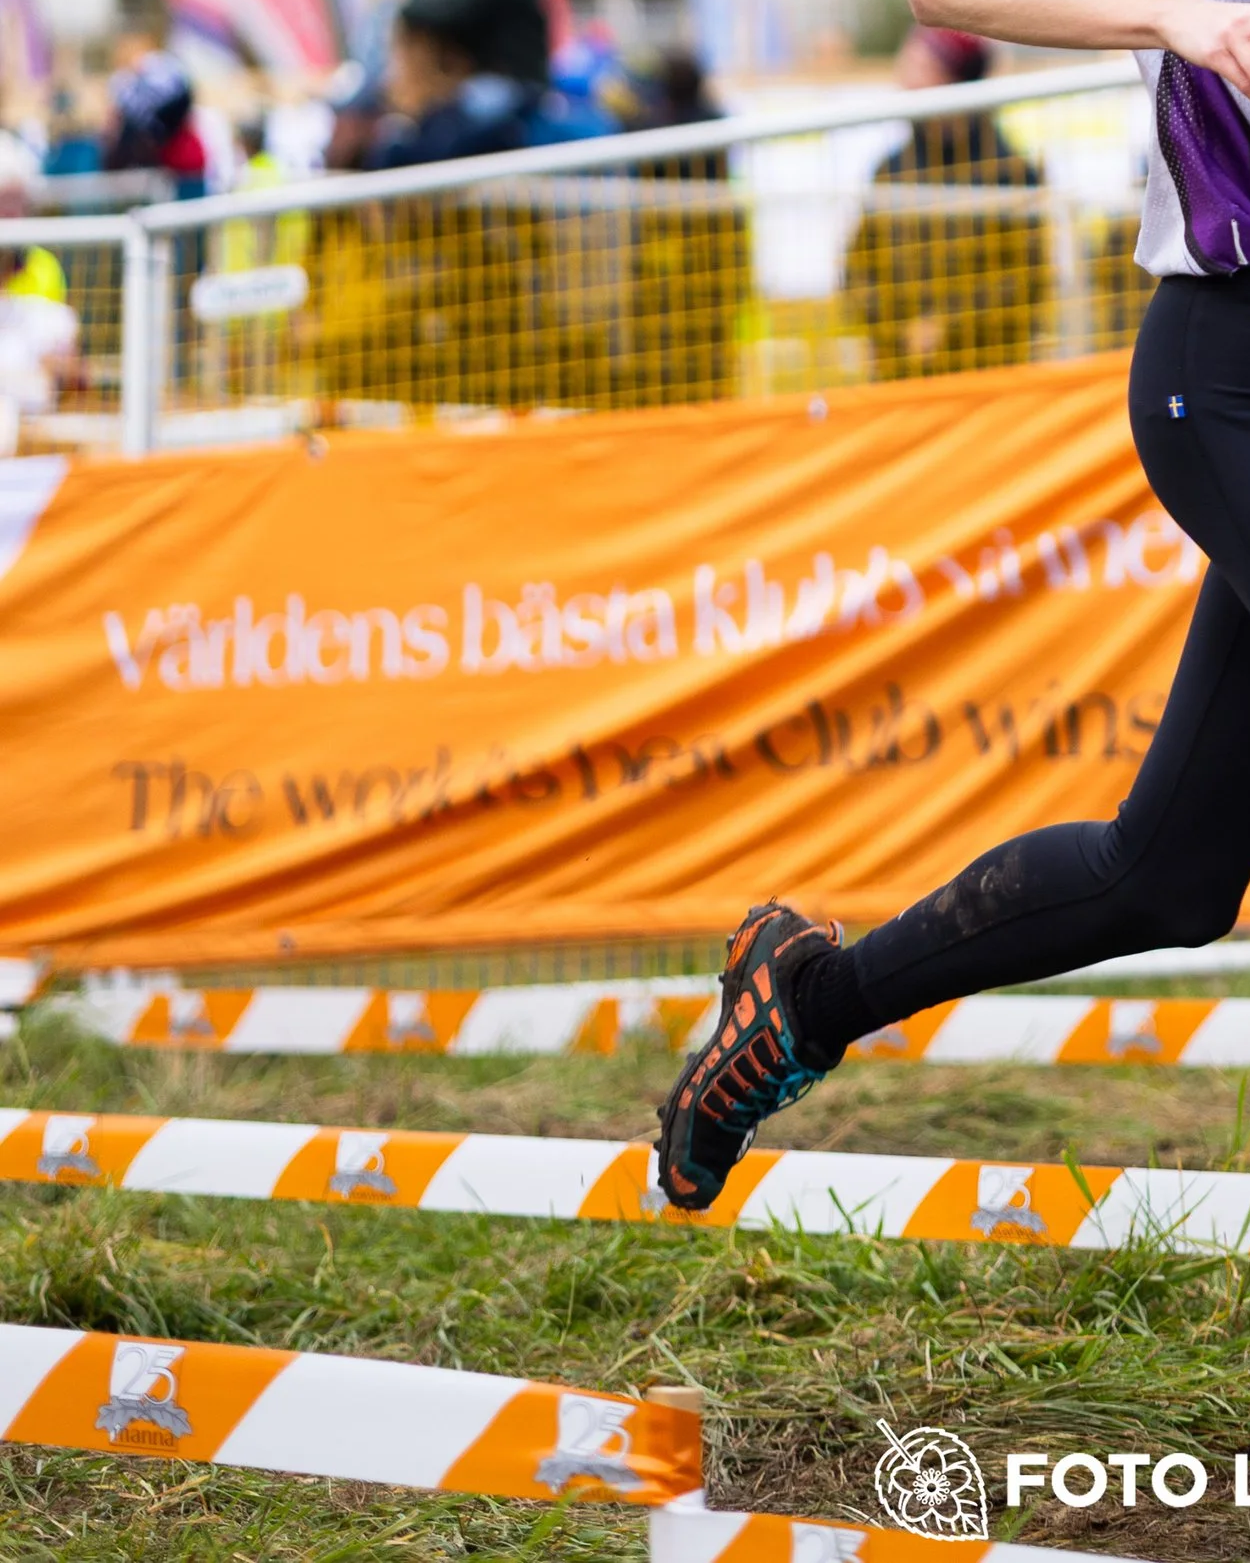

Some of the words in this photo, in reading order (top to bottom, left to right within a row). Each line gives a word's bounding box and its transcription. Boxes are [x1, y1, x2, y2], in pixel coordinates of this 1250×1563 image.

[103, 592, 449, 692] Världens
[460, 580, 679, 675] bästa
[112, 754, 265, 839] The
[117, 1346, 175, 1405] 25
[562, 1400, 632, 1459] 25
